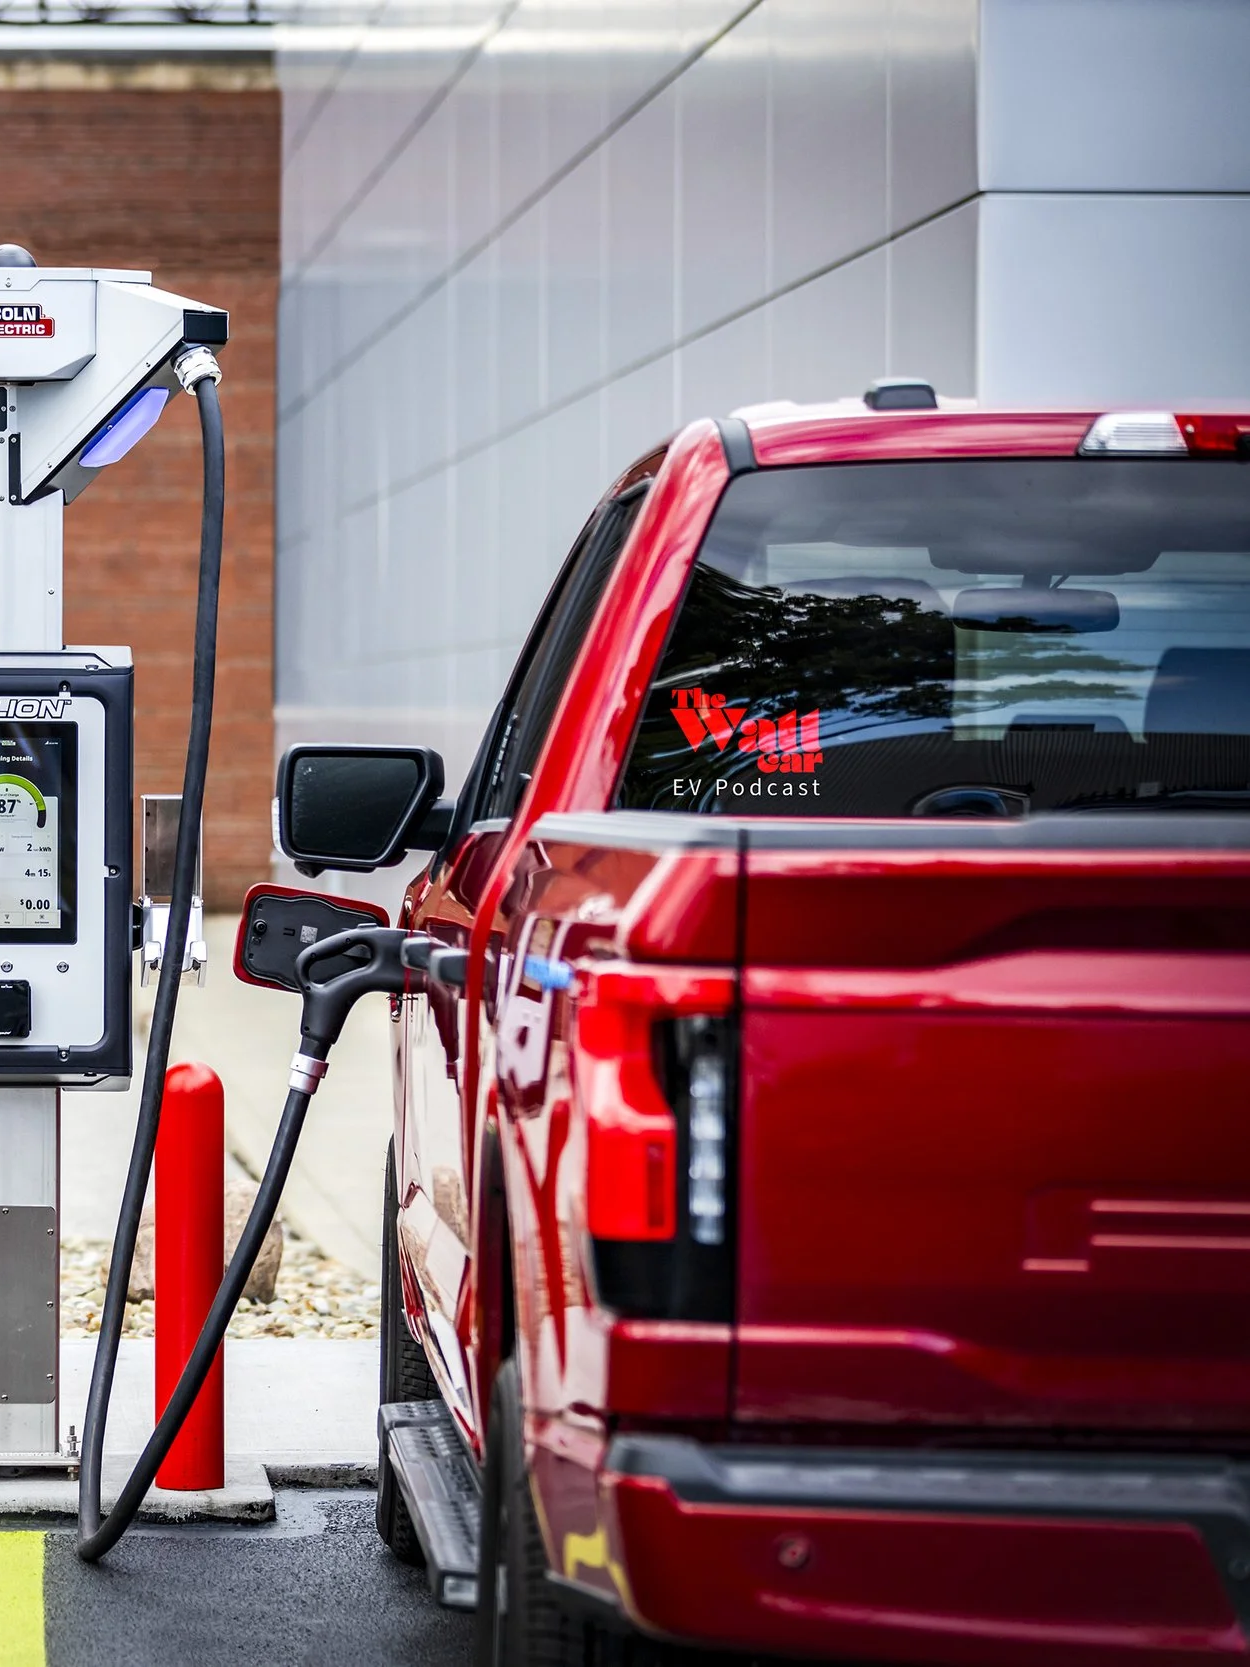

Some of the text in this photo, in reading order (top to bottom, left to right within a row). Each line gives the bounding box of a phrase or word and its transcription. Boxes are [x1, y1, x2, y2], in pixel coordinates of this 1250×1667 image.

[671, 687, 727, 709] The
[669, 707, 823, 753] Watt
[673, 777, 821, 796] EV Podcast
[19, 898, 51, 910] $0.00
